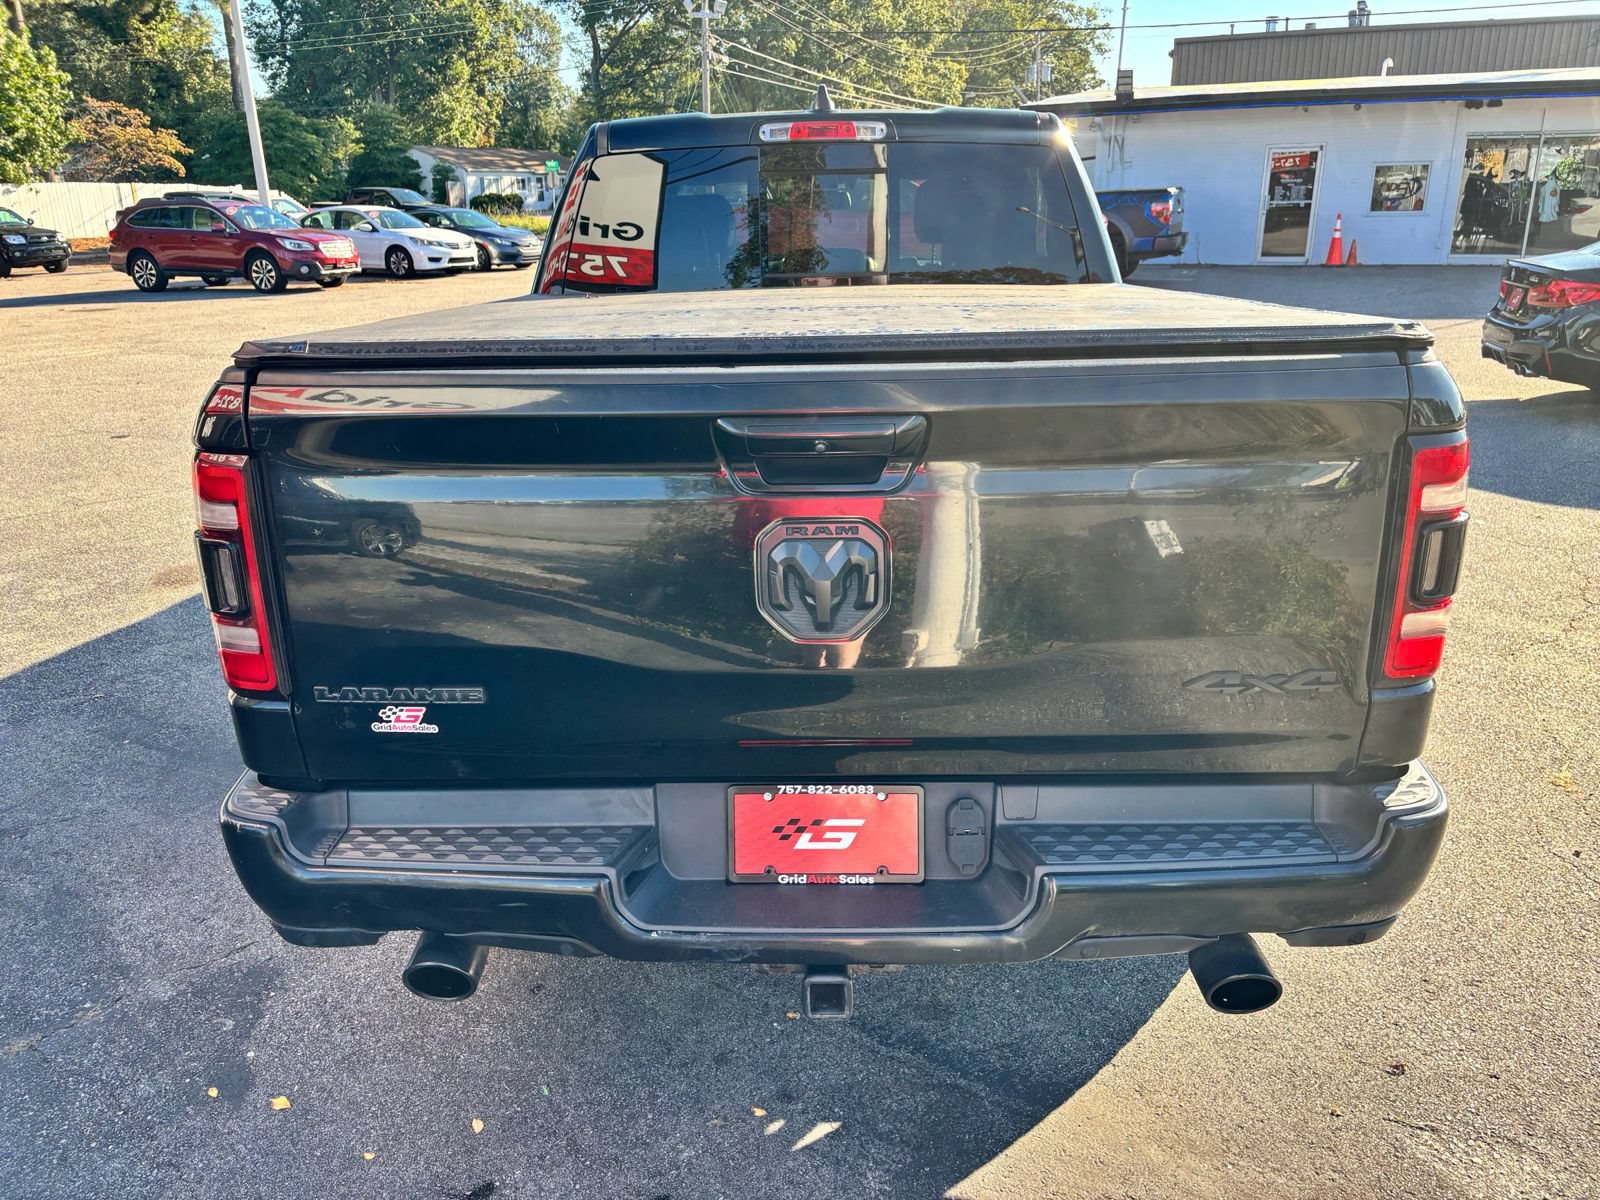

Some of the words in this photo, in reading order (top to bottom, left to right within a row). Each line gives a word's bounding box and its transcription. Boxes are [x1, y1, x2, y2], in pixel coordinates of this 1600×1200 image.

[785, 526, 859, 536] RAM
[313, 686, 485, 704] LARAMIE
[372, 723, 437, 732] GridAutoSales
[777, 785, 875, 795] 757-822-6083
[777, 874, 875, 884] GridAutoSales
